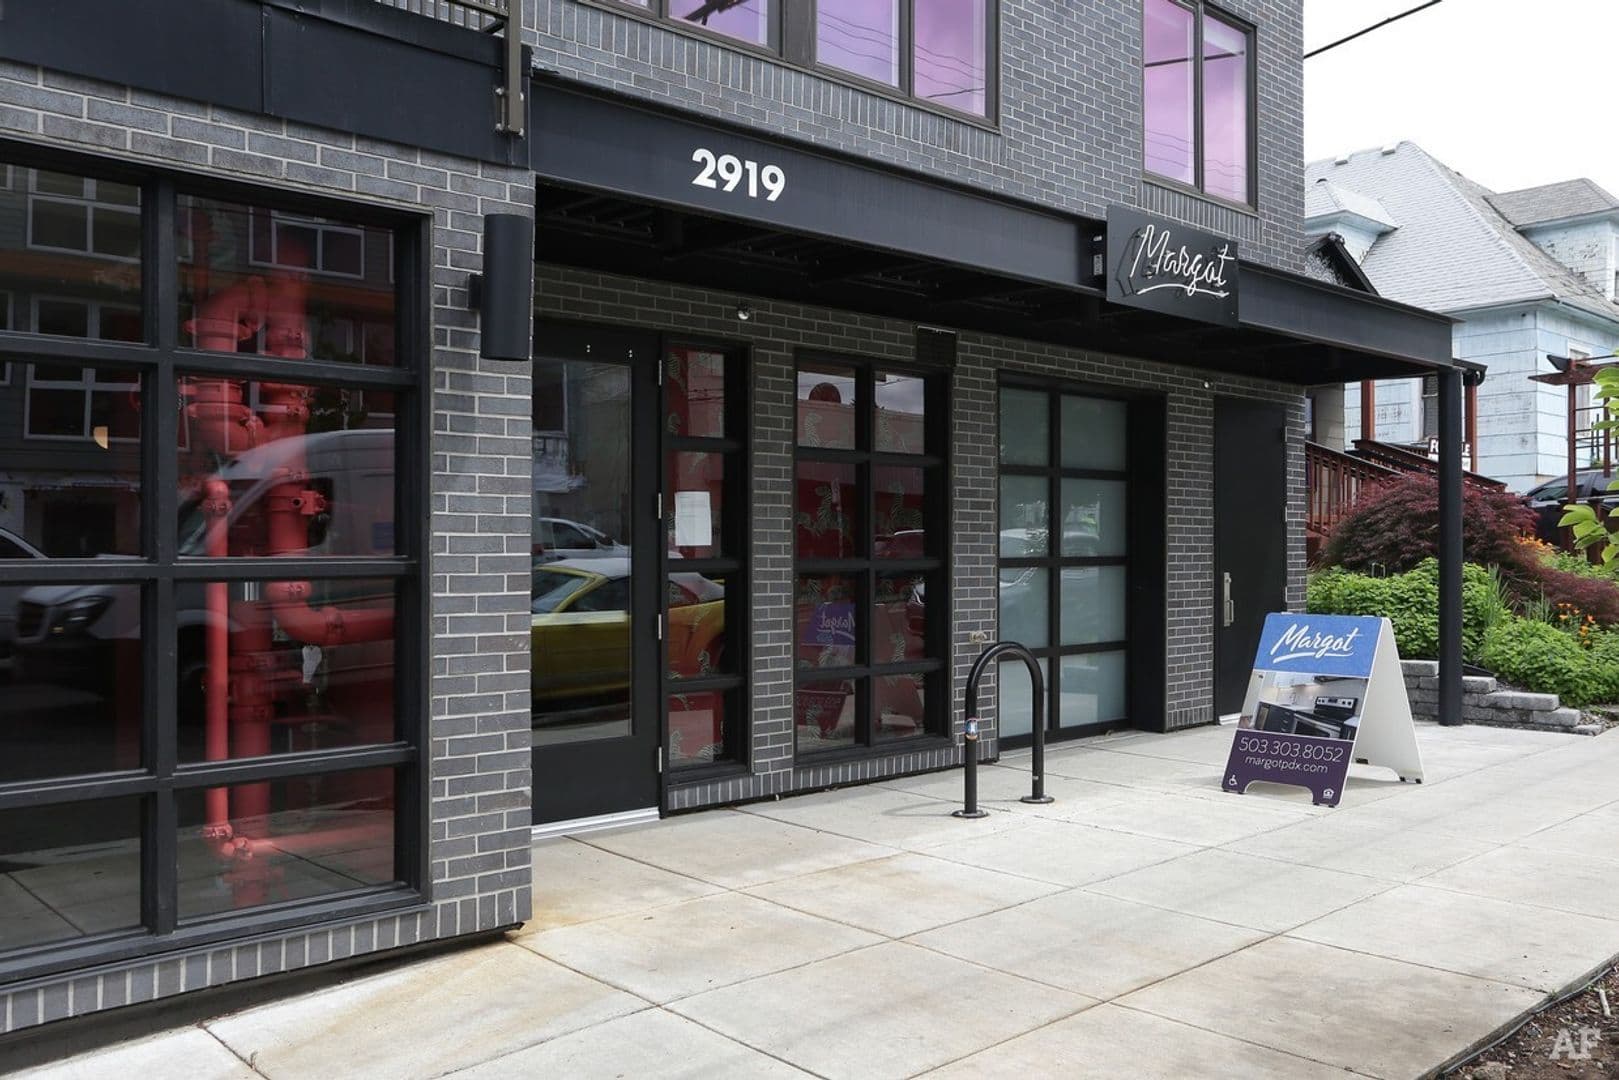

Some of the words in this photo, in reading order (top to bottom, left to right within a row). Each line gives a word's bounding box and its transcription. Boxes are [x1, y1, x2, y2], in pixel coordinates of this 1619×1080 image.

[692, 148, 786, 202] 2919
[1129, 224, 1235, 297] Margot
[1270, 623, 1363, 663] Margot
[1238, 737, 1344, 763] 503.303.8052
[1245, 755, 1328, 773] margotpdx.com
